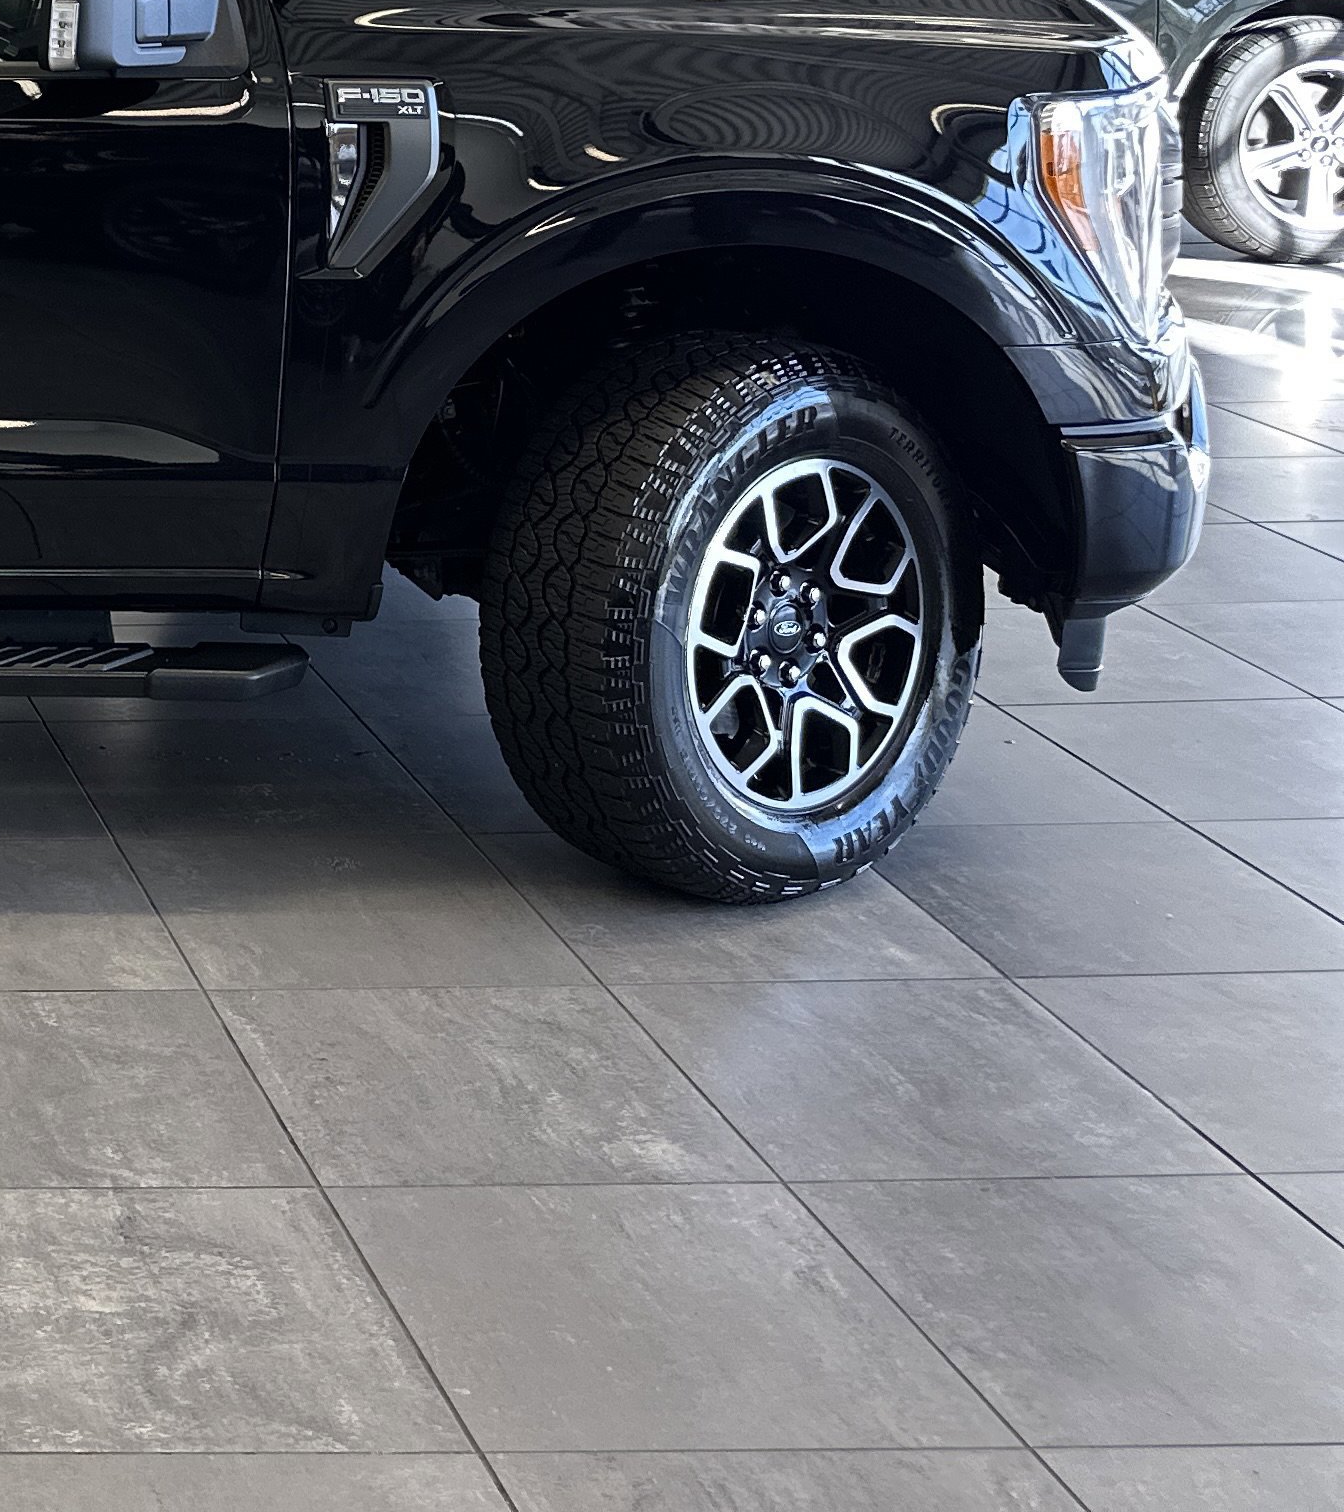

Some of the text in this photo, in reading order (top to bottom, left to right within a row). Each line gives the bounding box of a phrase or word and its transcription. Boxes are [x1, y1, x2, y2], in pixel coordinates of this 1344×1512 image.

[337, 87, 425, 104] F-150
[398, 105, 424, 114] XLT
[663, 405, 818, 607] WRANGLER
[888, 426, 953, 510] TERRITOR
[831, 653, 972, 866] GOODYEAR
